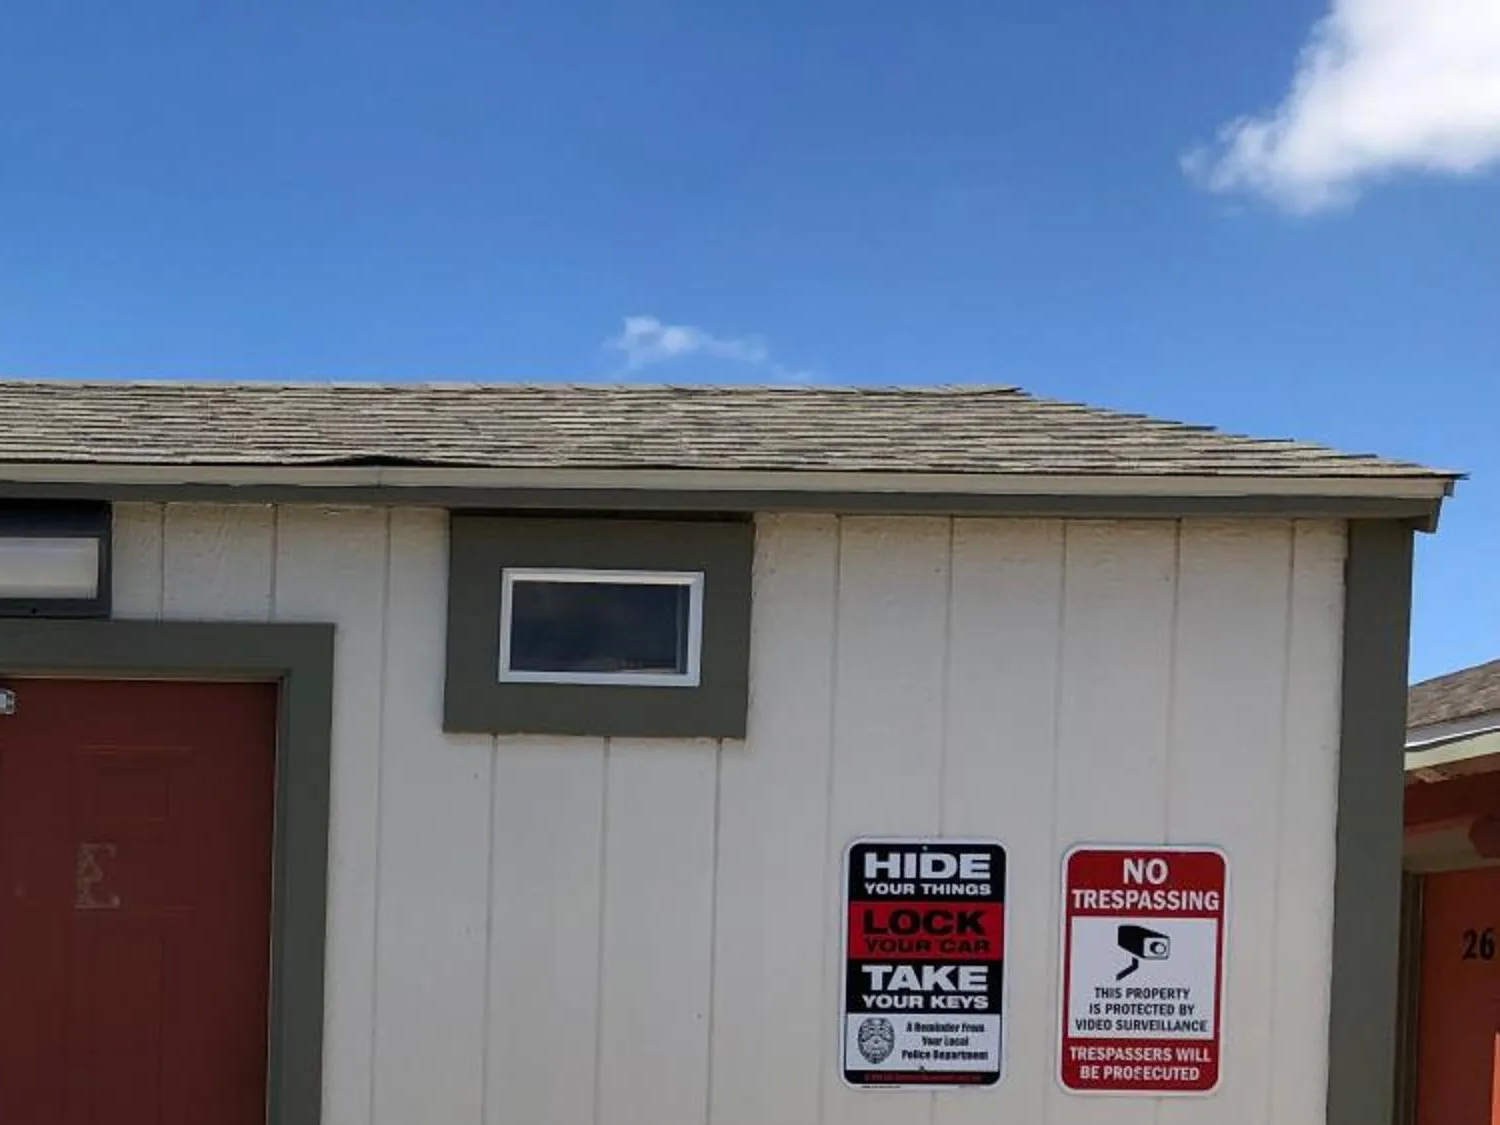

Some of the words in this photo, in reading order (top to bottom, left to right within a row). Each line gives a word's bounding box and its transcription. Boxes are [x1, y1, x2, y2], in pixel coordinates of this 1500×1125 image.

[864, 852, 991, 880] HIDE
[1123, 858, 1169, 885] NO
[864, 883, 915, 895] YOUR
[920, 883, 992, 896] THINGS
[1071, 889, 1220, 911] TRESPASSING
[863, 908, 985, 935] LOCK
[864, 939, 932, 953] YOUR
[939, 939, 991, 953] CAR
[1462, 928, 1495, 960] 26
[861, 965, 989, 992] TAKE
[1094, 987, 1122, 999] THIS
[1126, 988, 1191, 1001] PROPERTY
[862, 995, 924, 1008] YOUR
[930, 995, 989, 1009] KEYS
[1089, 1003, 1101, 1014] IS
[1105, 1003, 1175, 1016] PROTECTED
[1179, 1004, 1196, 1016] BY
[1075, 1019, 1113, 1031] VIDEO
[1115, 1019, 1209, 1032] SURVEILLANCE
[902, 1049, 931, 1061] Police
[933, 1050, 989, 1061] Department
[1070, 1047, 1172, 1061] TRESPASSERS
[1175, 1048, 1212, 1062] WILL
[1079, 1065, 1101, 1079] BE
[1103, 1066, 1200, 1080] PROSECUTED
